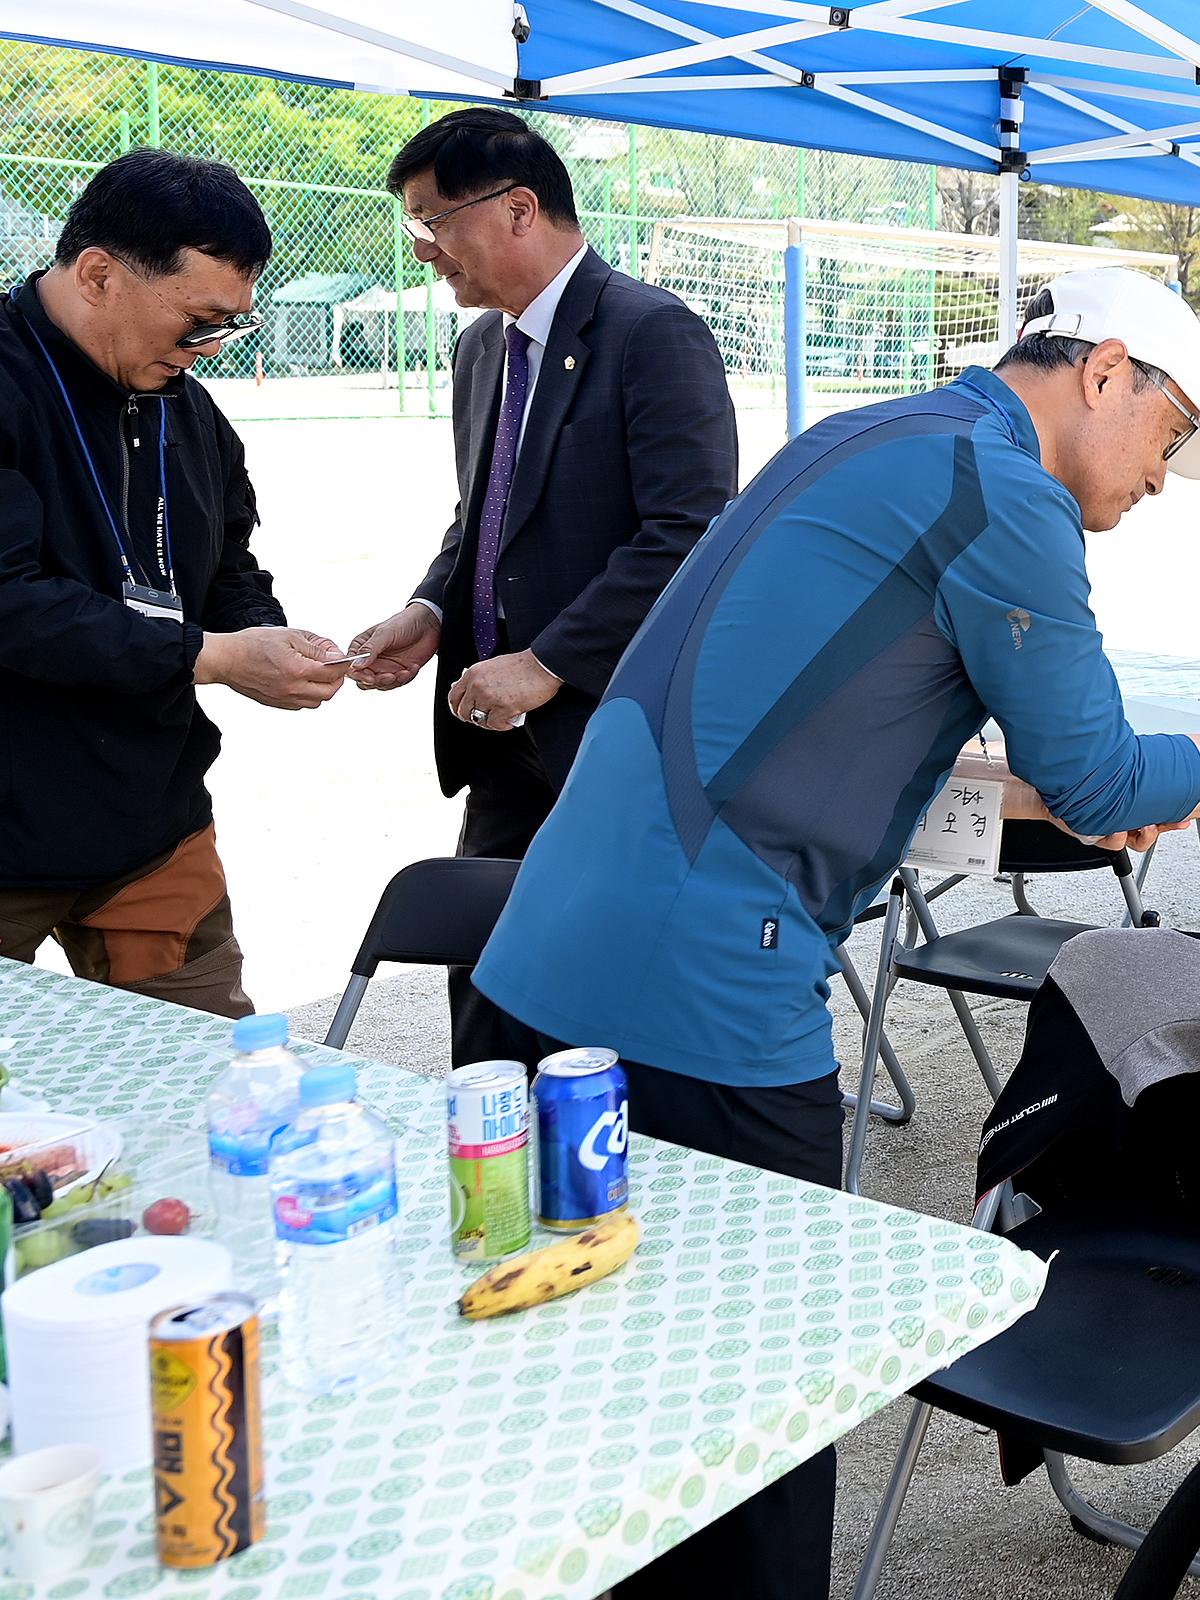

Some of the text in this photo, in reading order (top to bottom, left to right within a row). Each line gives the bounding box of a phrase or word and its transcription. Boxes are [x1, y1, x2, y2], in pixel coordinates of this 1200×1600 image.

[157, 497, 165, 511] ALL
[157, 513, 164, 525] WE
[158, 558, 167, 576] NOW
